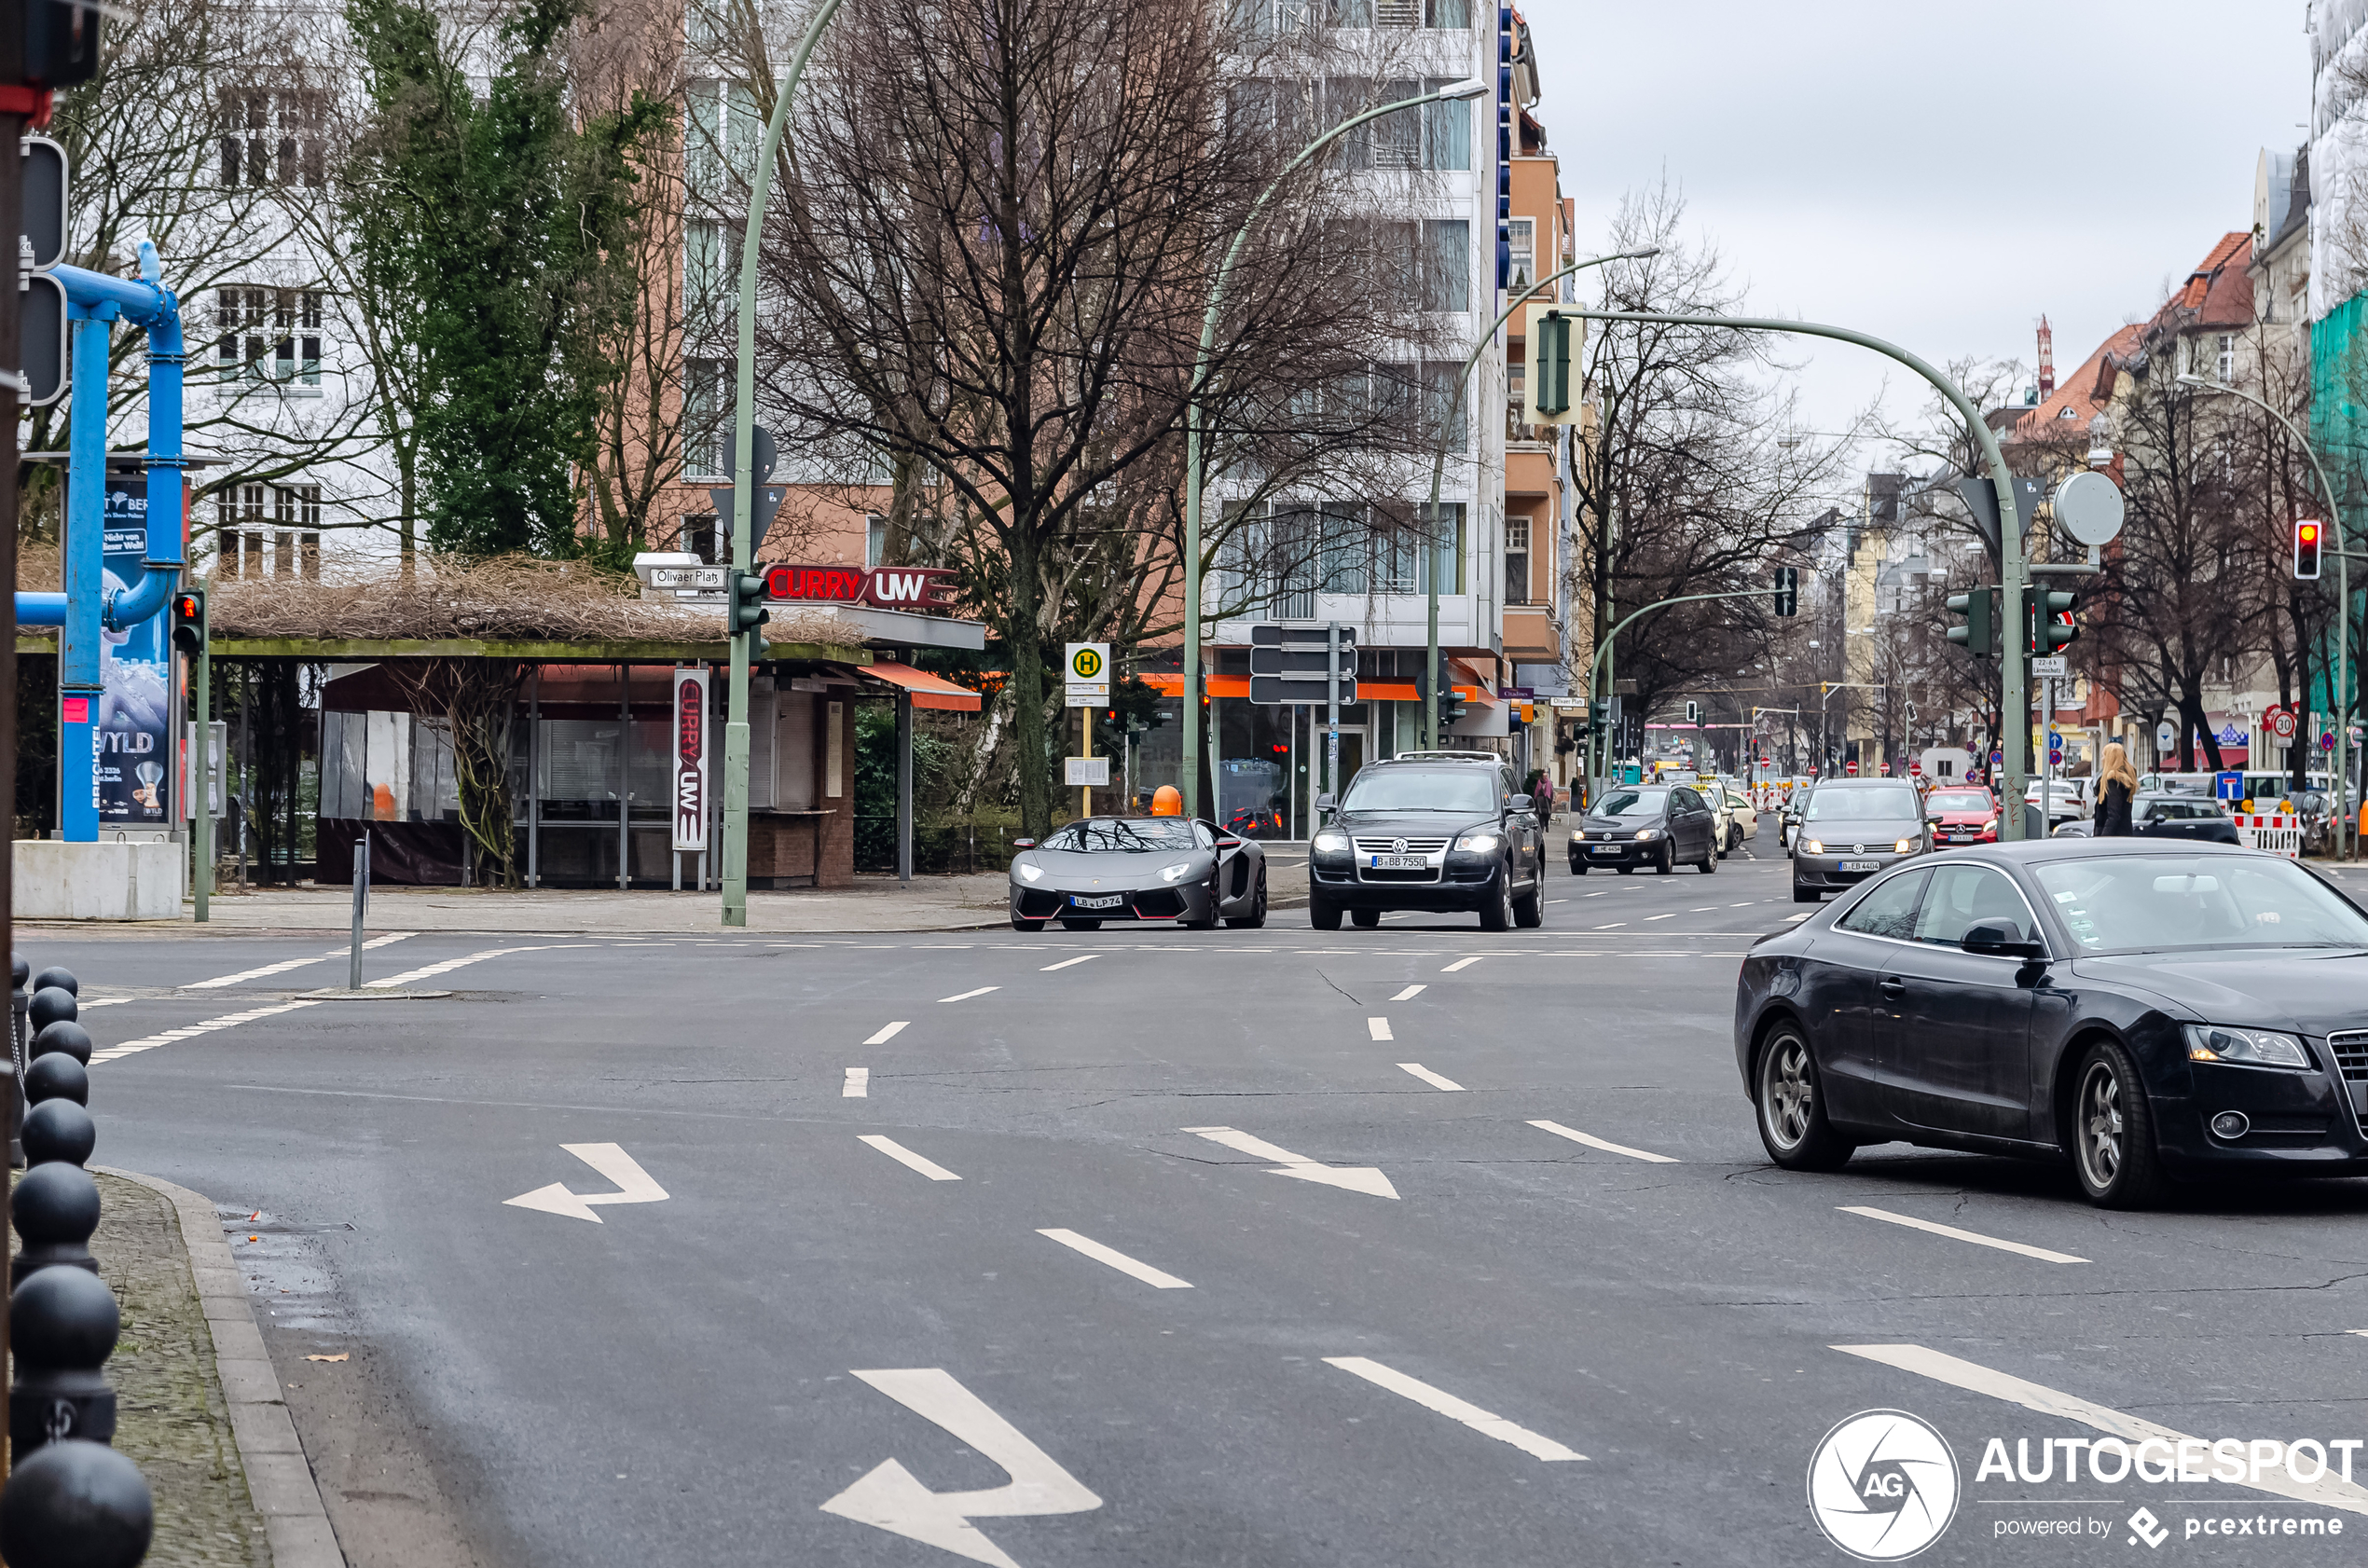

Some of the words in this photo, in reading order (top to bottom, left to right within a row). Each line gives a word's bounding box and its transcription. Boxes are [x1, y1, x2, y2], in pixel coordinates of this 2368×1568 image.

[104, 532, 124, 542] Nicht
[657, 571, 693, 582] Olivaer
[768, 570, 860, 598] CURRY
[875, 573, 924, 600] UW
[681, 683, 699, 757] CURRY
[2278, 719, 2291, 731] 30
[680, 772, 698, 811] UW
[1377, 857, 1384, 866] B
[1389, 857, 1400, 866] BB
[1403, 858, 1425, 867] 7550
[1077, 898, 1088, 907] LB
[1095, 899, 1108, 908] LP
[1109, 898, 1121, 906] 74
